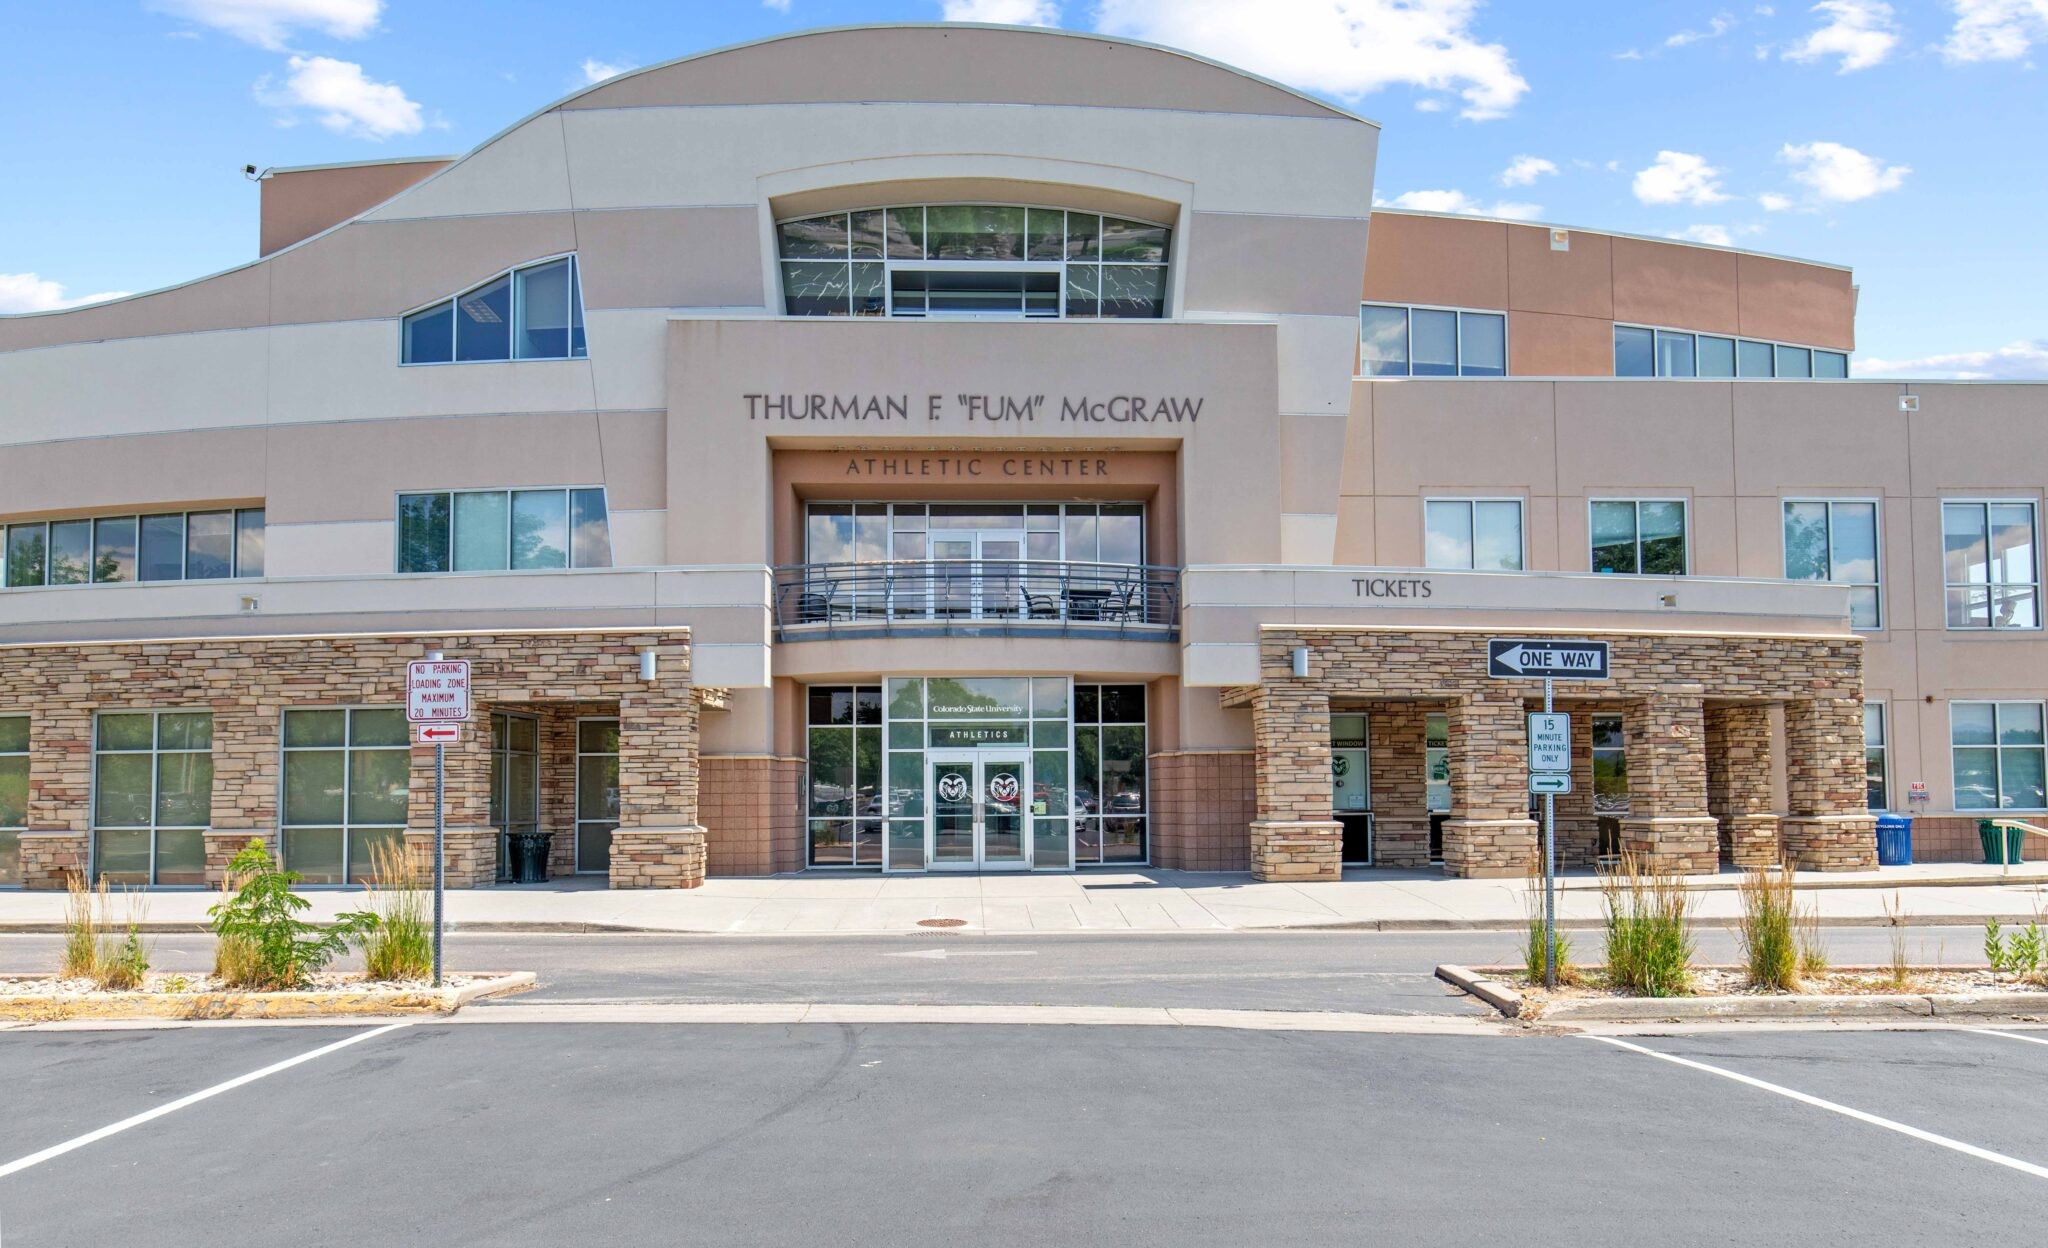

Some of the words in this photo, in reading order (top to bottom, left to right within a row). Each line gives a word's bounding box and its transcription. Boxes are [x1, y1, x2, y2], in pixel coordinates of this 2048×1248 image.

[743, 394, 908, 420] THURMAN
[929, 395, 942, 421] F.
[1060, 396, 1204, 422] McGRAW
[846, 458, 982, 476] ATHLETIC
[1003, 459, 1108, 476] CENTER
[1351, 579, 1432, 598] TICKETS
[1519, 651, 1552, 667] ONE
[1561, 652, 1595, 668] WAY
[415, 665, 425, 674] NO
[433, 664, 462, 674] PARKING
[411, 679, 442, 689] LOADING
[447, 678, 466, 688] ZONE
[421, 693, 455, 703] MAXIMUM
[414, 708, 424, 718] 20
[431, 707, 462, 717] MINUTES
[933, 705, 966, 713] Colorado
[966, 704, 985, 714] State
[985, 704, 1023, 715] University
[1543, 719, 1555, 731] 15
[949, 730, 1009, 739] ATHLETICS
[1537, 734, 1563, 742] MINUTE
[1533, 744, 1567, 752] PARKING
[1541, 755, 1559, 763] ONLY
